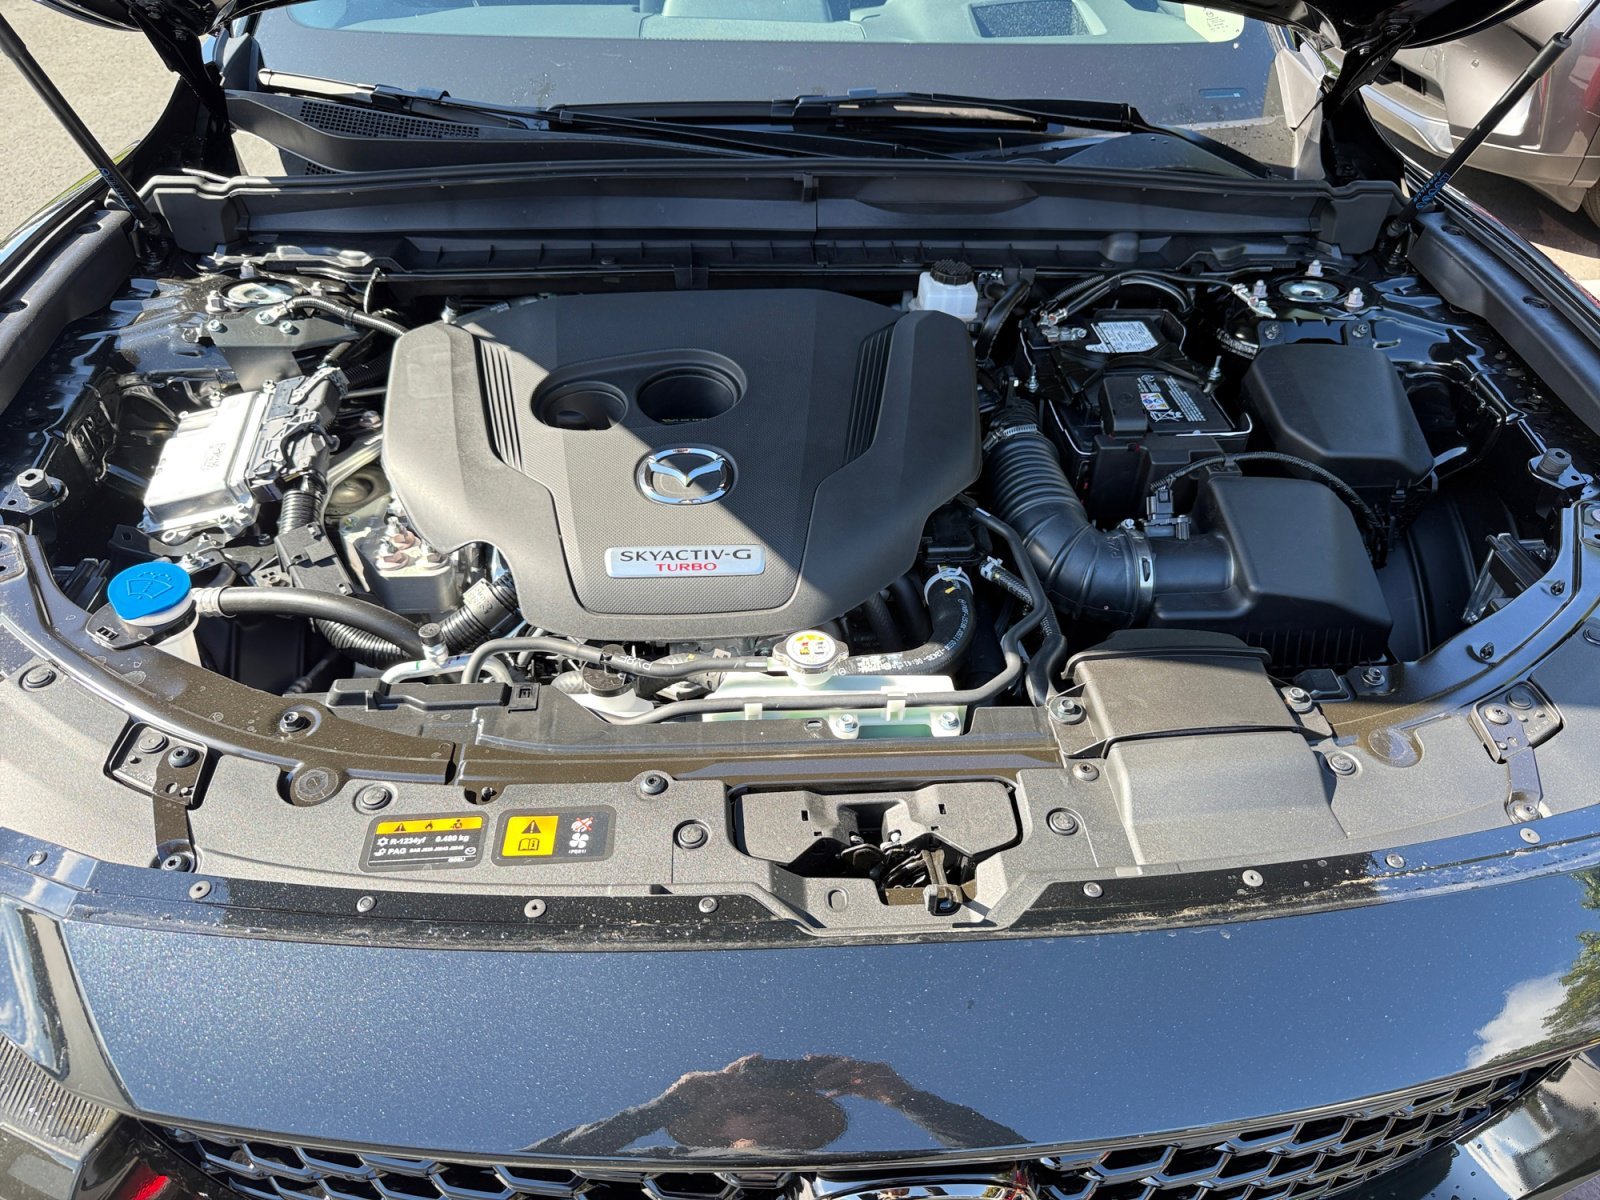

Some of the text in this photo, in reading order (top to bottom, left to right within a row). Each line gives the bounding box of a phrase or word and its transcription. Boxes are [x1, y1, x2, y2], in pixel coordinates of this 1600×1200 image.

[620, 549, 752, 563] SKYACTIV-G
[656, 563, 717, 572] TURBO
[389, 837, 427, 846] R-1234yf
[458, 834, 470, 842] kg
[387, 848, 407, 856] PAG
